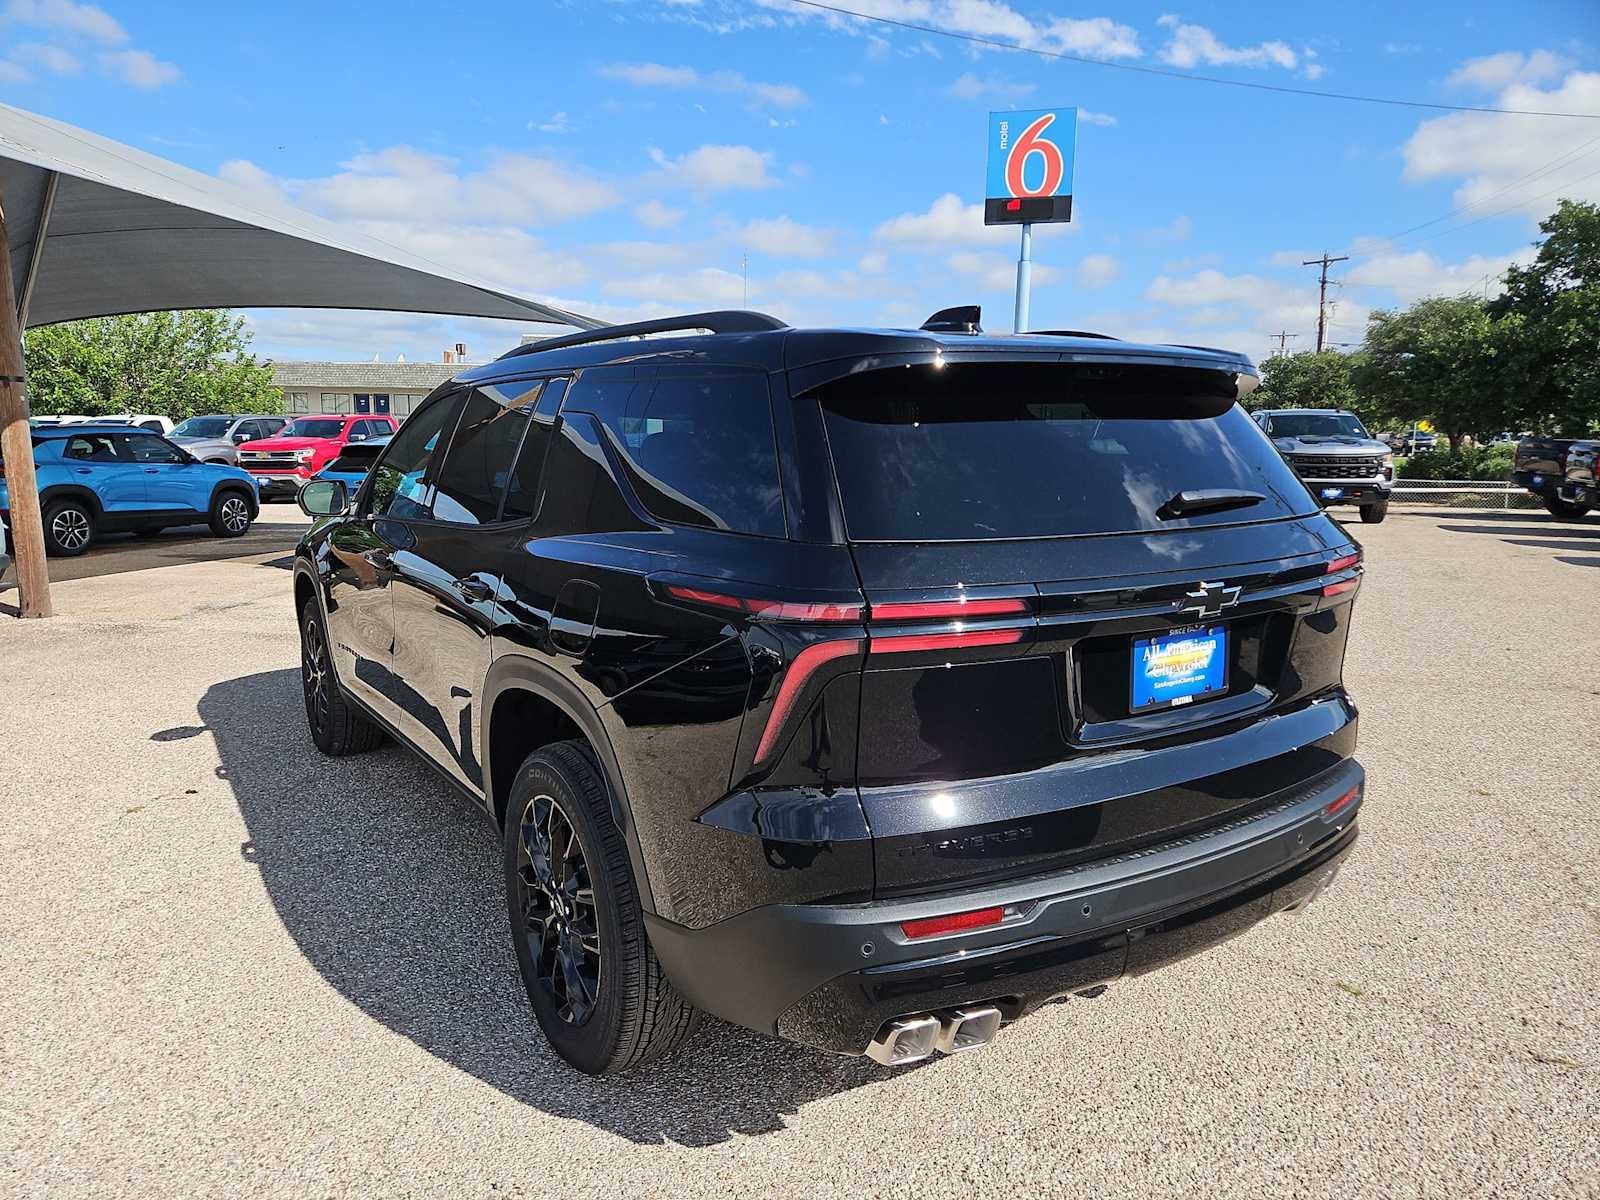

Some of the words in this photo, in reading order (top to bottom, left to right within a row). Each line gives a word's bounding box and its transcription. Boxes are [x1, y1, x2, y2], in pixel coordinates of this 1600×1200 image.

[1000, 120, 1008, 150] motel
[1005, 113, 1063, 198] 6
[1142, 644, 1161, 662] All
